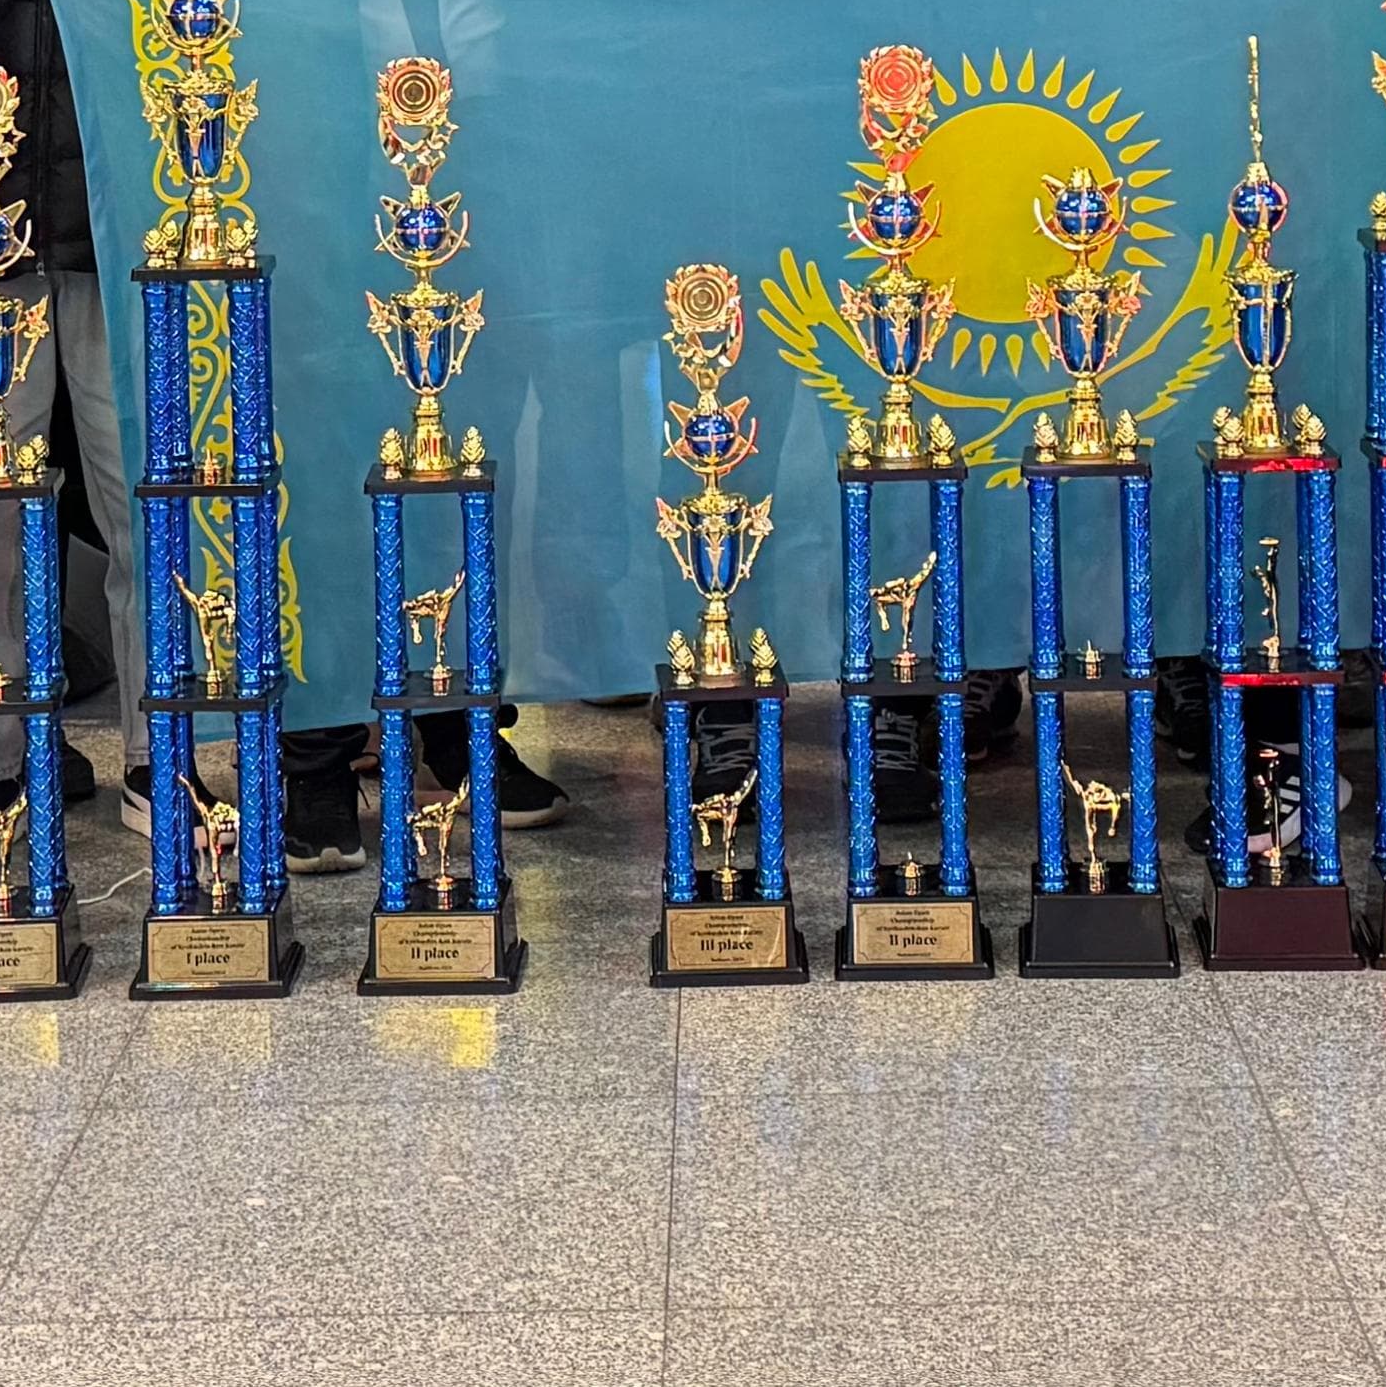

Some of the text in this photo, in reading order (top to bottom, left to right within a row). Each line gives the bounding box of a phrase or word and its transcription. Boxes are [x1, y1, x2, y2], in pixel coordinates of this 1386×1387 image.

[701, 939, 753, 953] III place
[889, 934, 937, 948] II place
[187, 952, 229, 966] I place
[411, 947, 459, 961] II place
